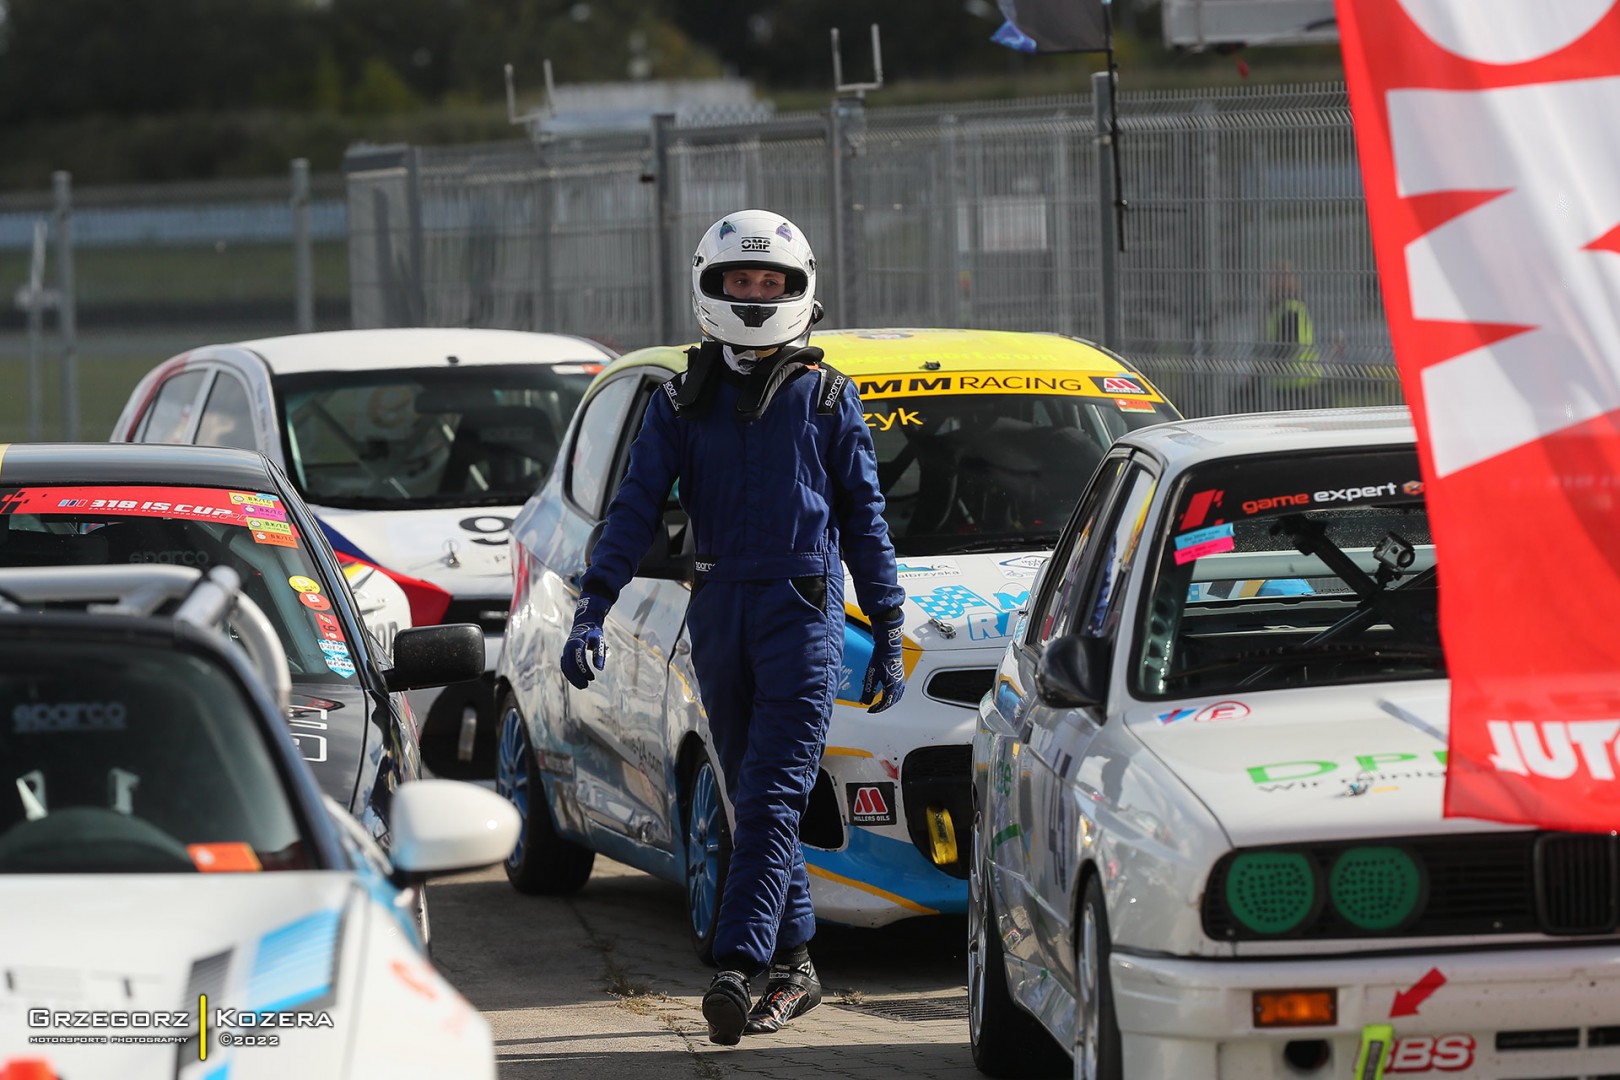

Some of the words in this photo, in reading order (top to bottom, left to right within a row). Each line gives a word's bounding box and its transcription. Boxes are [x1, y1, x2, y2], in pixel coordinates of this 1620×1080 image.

[741, 238, 771, 250] OMP
[824, 375, 846, 409] sparco
[959, 375, 1082, 392] RACING
[1242, 492, 1310, 515] game
[1313, 481, 1397, 504] expert
[90, 499, 138, 509] 318
[141, 501, 172, 511] IS
[173, 504, 233, 516] CUP
[1257, 780, 1319, 793] Wir
[1356, 1032, 1477, 1075] BS
